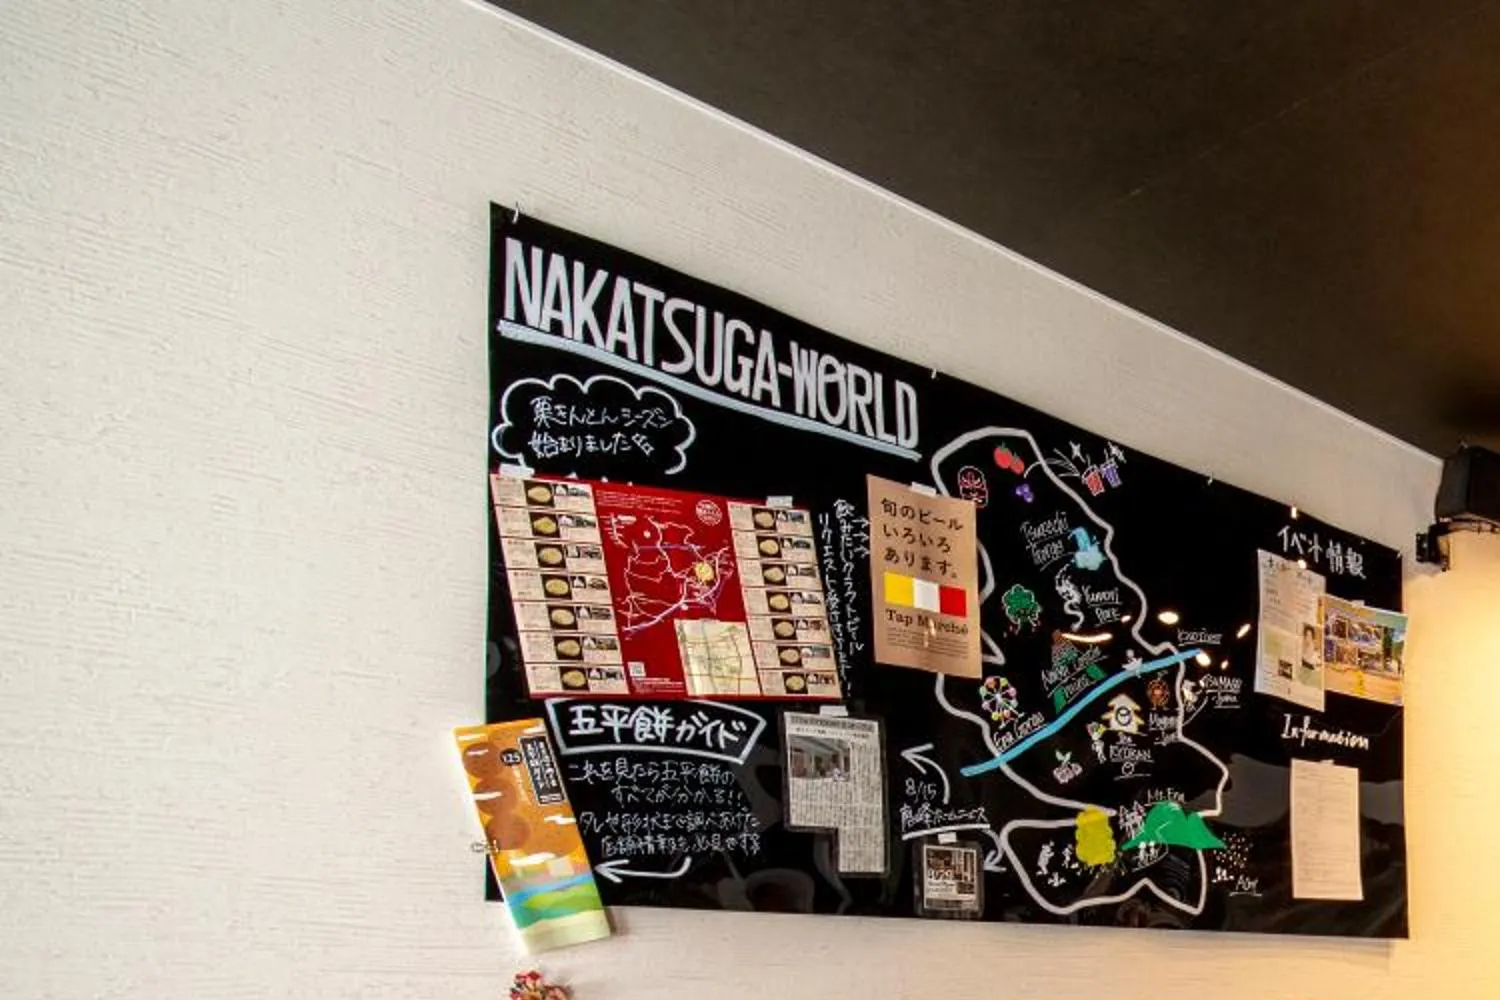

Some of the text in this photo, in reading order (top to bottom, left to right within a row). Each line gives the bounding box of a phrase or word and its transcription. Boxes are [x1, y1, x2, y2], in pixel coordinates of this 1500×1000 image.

[881, 499, 963, 531] 旬のビール
[883, 524, 951, 553] いろいろ
[883, 547, 958, 579] あります。
[885, 608, 913, 627] Tap
[568, 704, 748, 750] 五平餅ガイド
